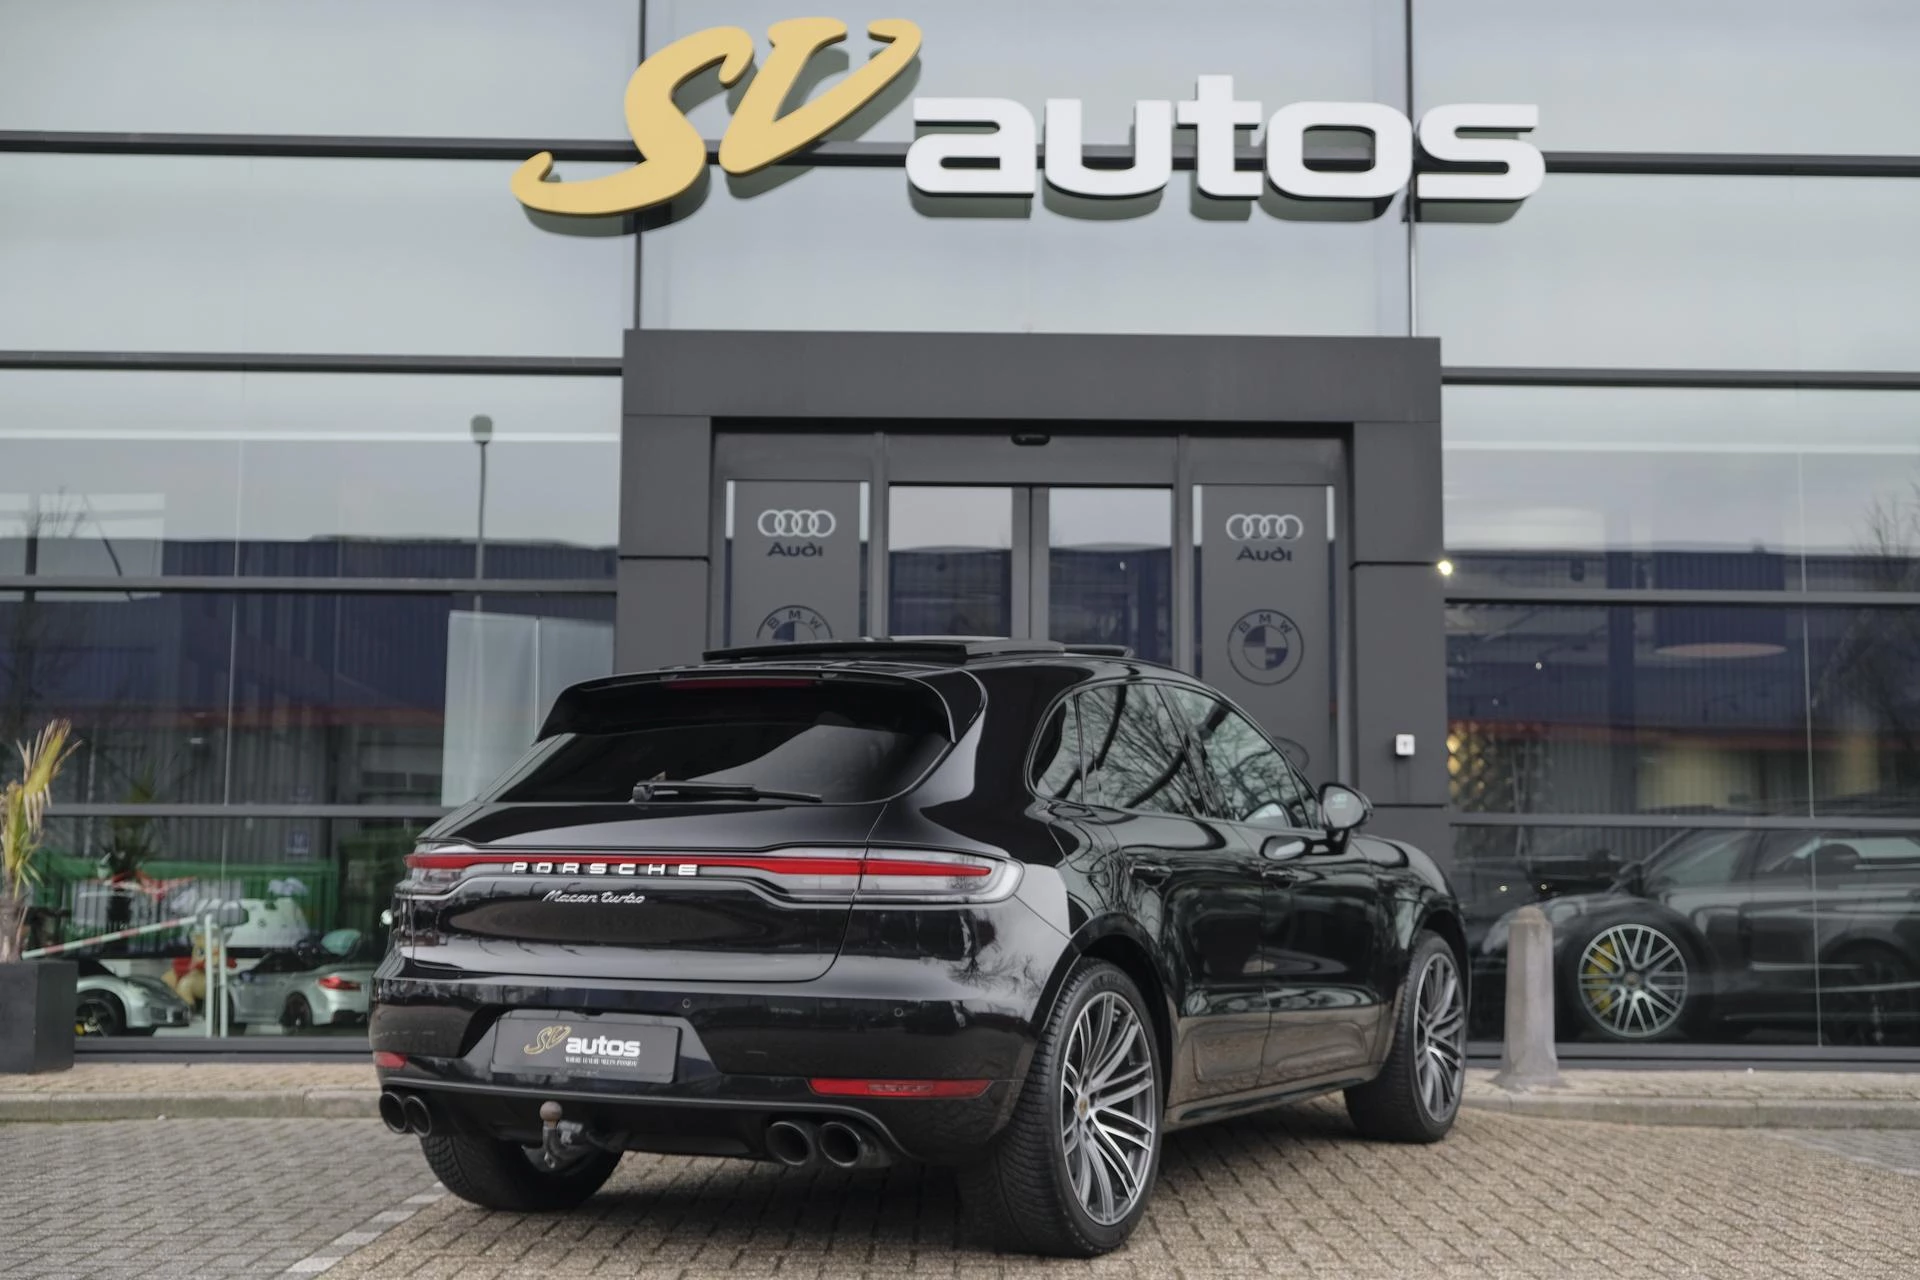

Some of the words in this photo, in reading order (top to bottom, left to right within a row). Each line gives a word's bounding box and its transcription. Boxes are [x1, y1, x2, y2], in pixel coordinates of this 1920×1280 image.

[510, 17, 922, 216] SV
[905, 75, 1546, 200] autos
[767, 541, 823, 557] Audi
[1236, 546, 1293, 562] Audi
[766, 609, 823, 630] BMW
[1238, 613, 1293, 634] BMW
[512, 862, 698, 876] PORSCHE
[541, 889, 599, 904] Macan
[600, 890, 646, 904] turbo
[565, 1035, 641, 1058] autos
